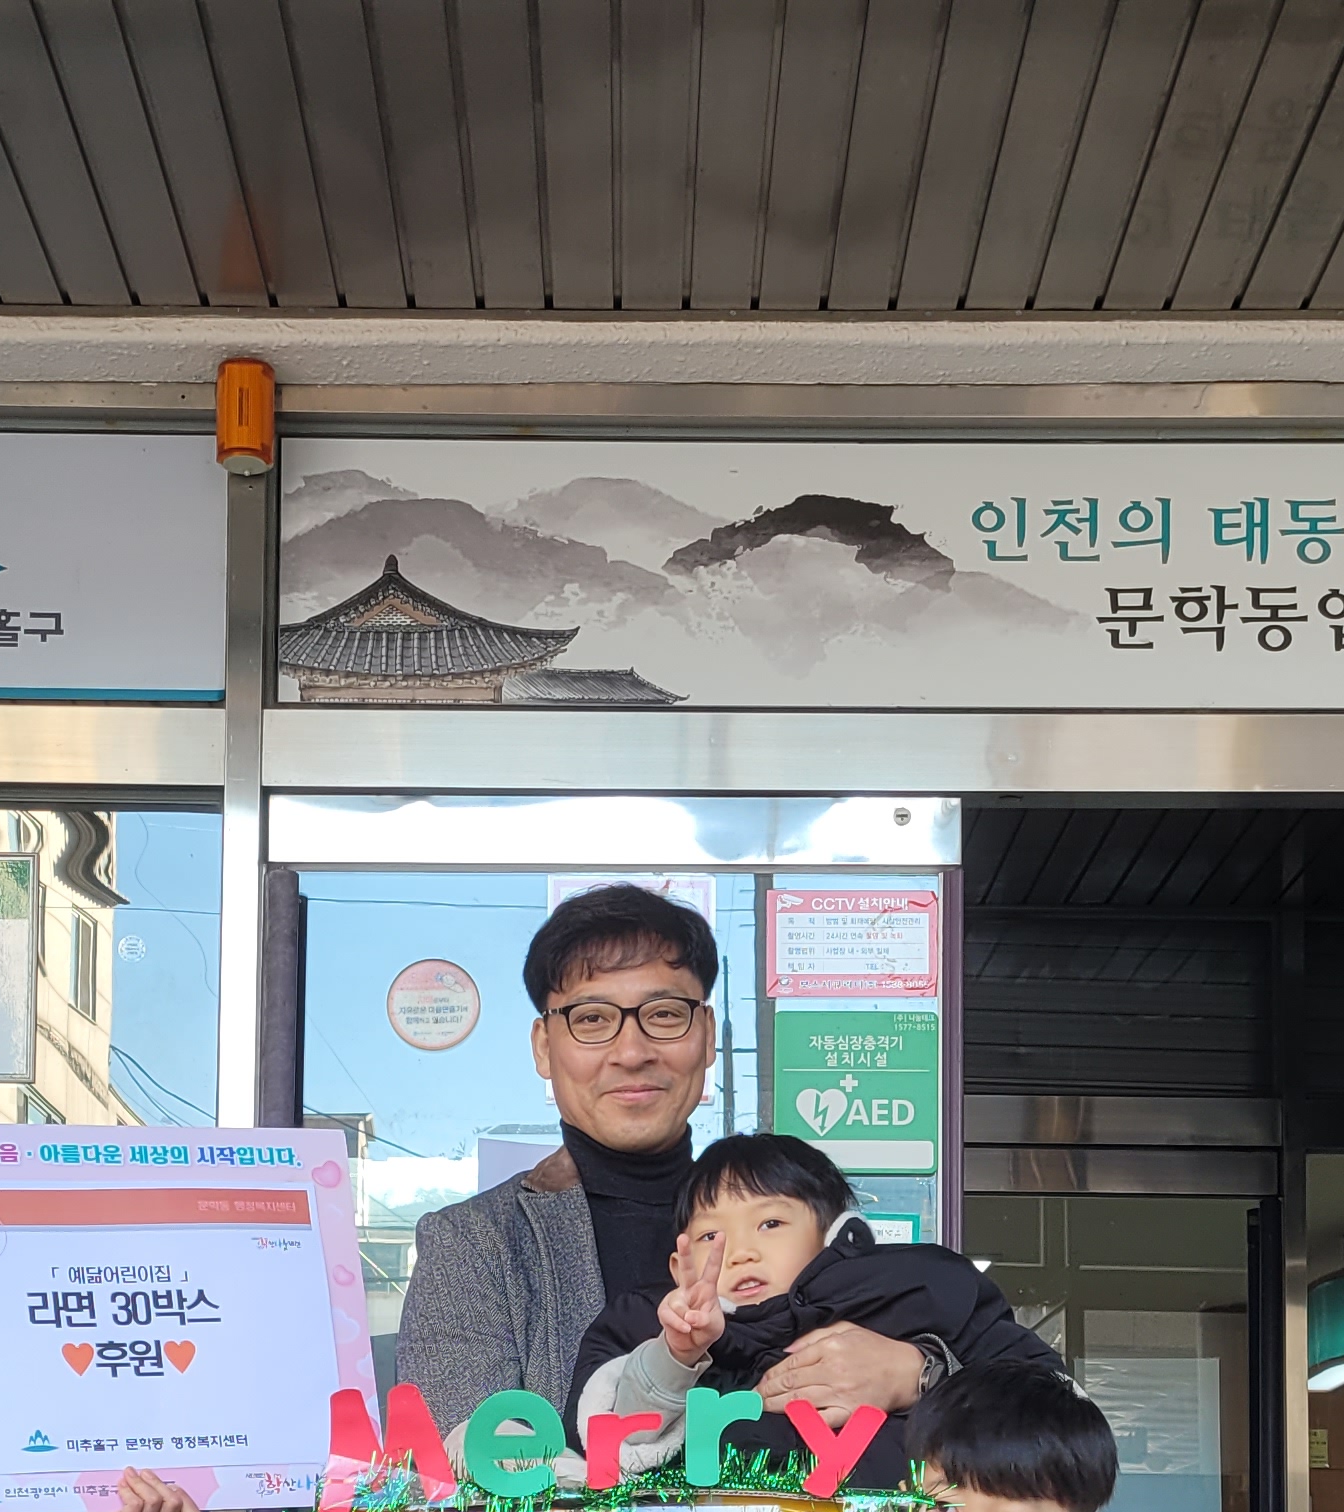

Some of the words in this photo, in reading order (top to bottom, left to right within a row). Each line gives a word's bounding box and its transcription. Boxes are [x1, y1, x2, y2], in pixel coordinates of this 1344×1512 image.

[970, 496, 1171, 564] 인천의
[812, 898, 856, 910] CCTV
[809, 1035, 903, 1050] 자동심장충격기
[825, 1052, 888, 1067] 설치시설
[846, 1099, 915, 1126] AED
[39, 1143, 122, 1165] 아름다운
[129, 1144, 189, 1165] 세상의
[196, 1145, 304, 1168] 시작입니다.
[27, 1290, 97, 1329] 라면
[111, 1289, 221, 1328] 30박스
[96, 1340, 164, 1378] 후원
[67, 1439, 119, 1452] 미추홀구
[126, 1437, 163, 1451] 문학동
[171, 1434, 248, 1450] 행정복지센터
